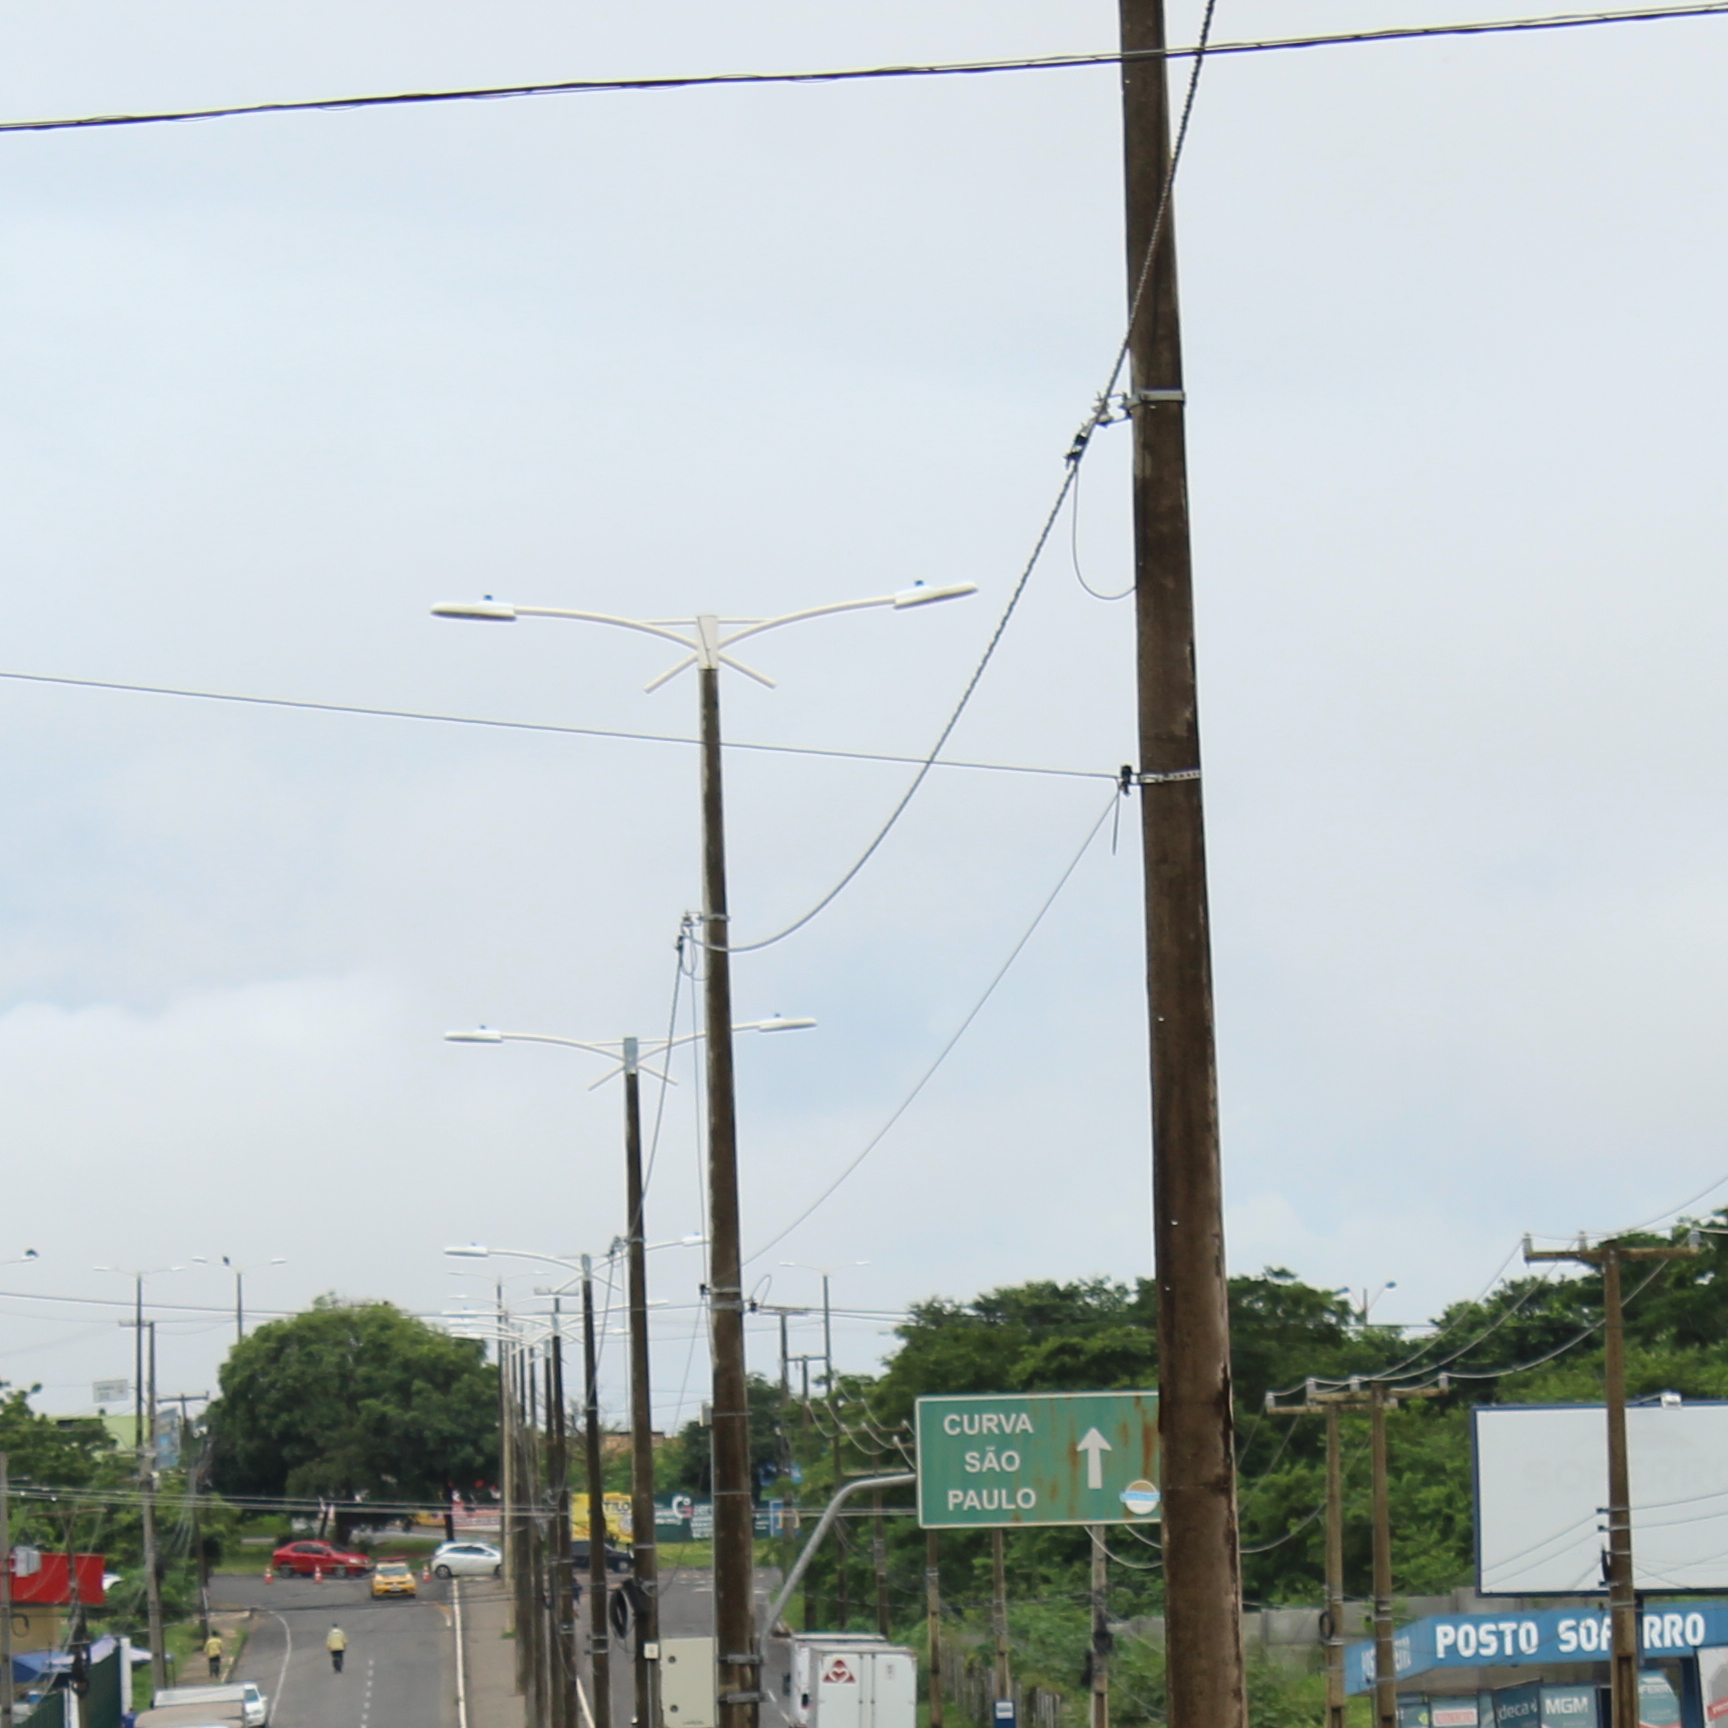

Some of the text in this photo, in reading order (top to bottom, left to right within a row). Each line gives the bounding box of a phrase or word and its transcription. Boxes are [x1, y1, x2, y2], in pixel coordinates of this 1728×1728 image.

[943, 1413, 1034, 1437] CURVA
[964, 1445, 1021, 1473] SÃO
[947, 1488, 1037, 1512] PAULO
[1435, 1622, 1540, 1660] POSTO
[1557, 1612, 1707, 1654] SOFRRO
[1545, 1697, 1589, 1715] MGM
